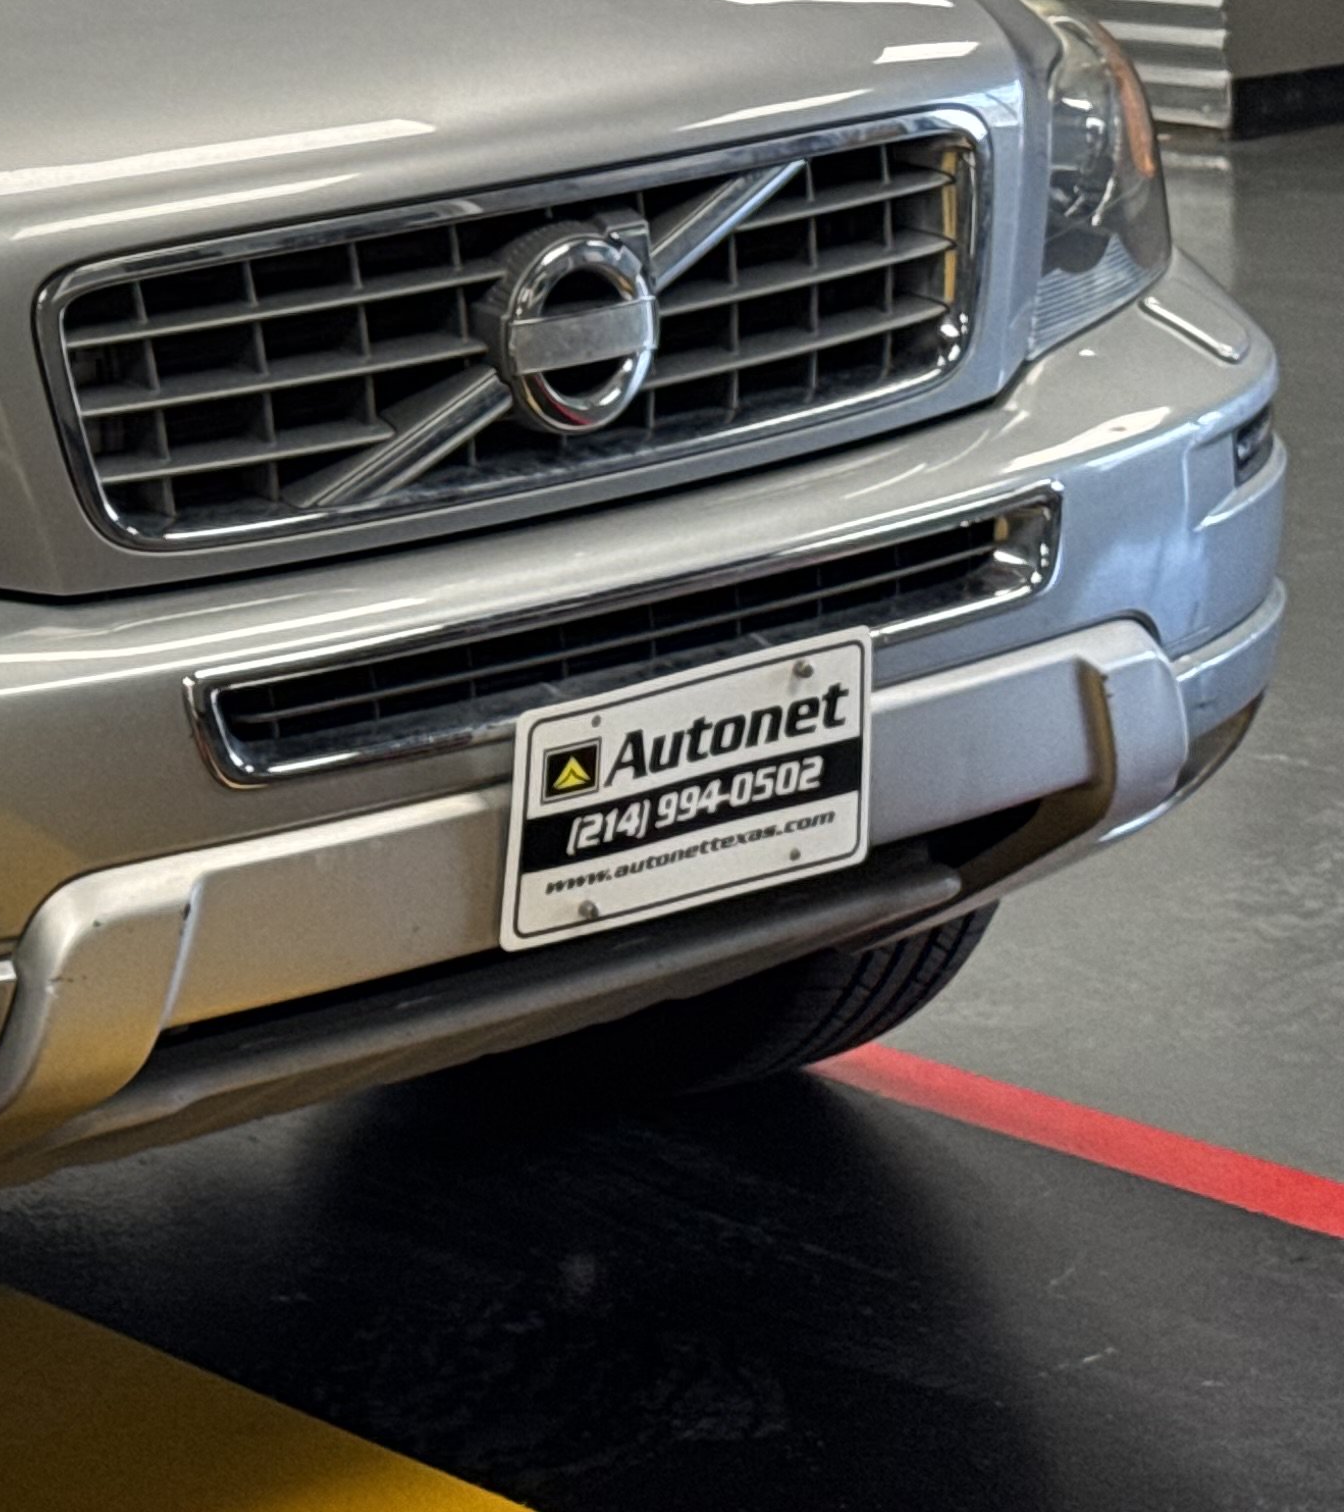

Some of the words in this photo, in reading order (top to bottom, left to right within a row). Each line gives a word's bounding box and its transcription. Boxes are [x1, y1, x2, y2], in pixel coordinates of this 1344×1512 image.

[604, 682, 849, 787] Autonet
[544, 810, 835, 896] www.autonettexas.com
[566, 801, 650, 856] (214)
[655, 755, 824, 828] 994-0502
